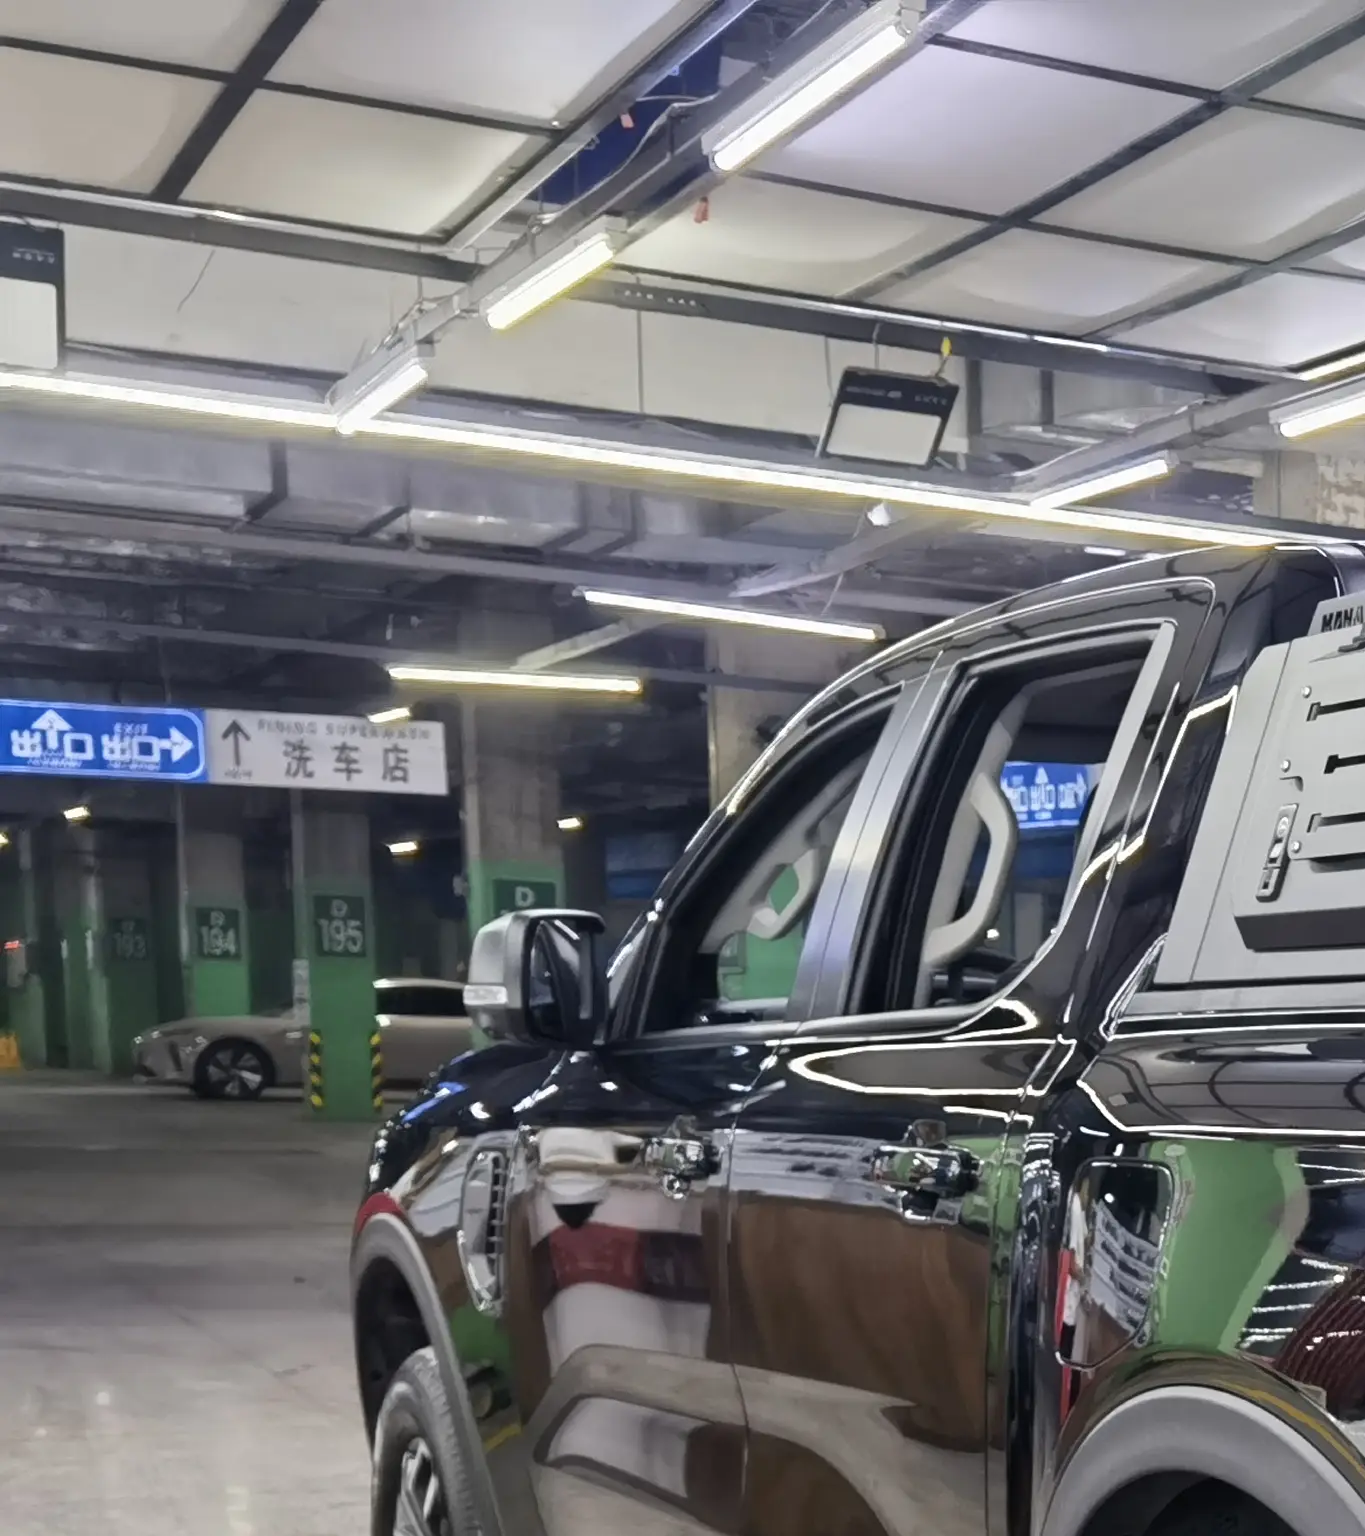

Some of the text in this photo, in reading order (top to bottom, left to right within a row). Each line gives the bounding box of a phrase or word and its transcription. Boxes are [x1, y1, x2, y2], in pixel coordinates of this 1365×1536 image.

[282, 740, 410, 783] 洗车店
[515, 886, 534, 908] D
[317, 917, 364, 954] 195
